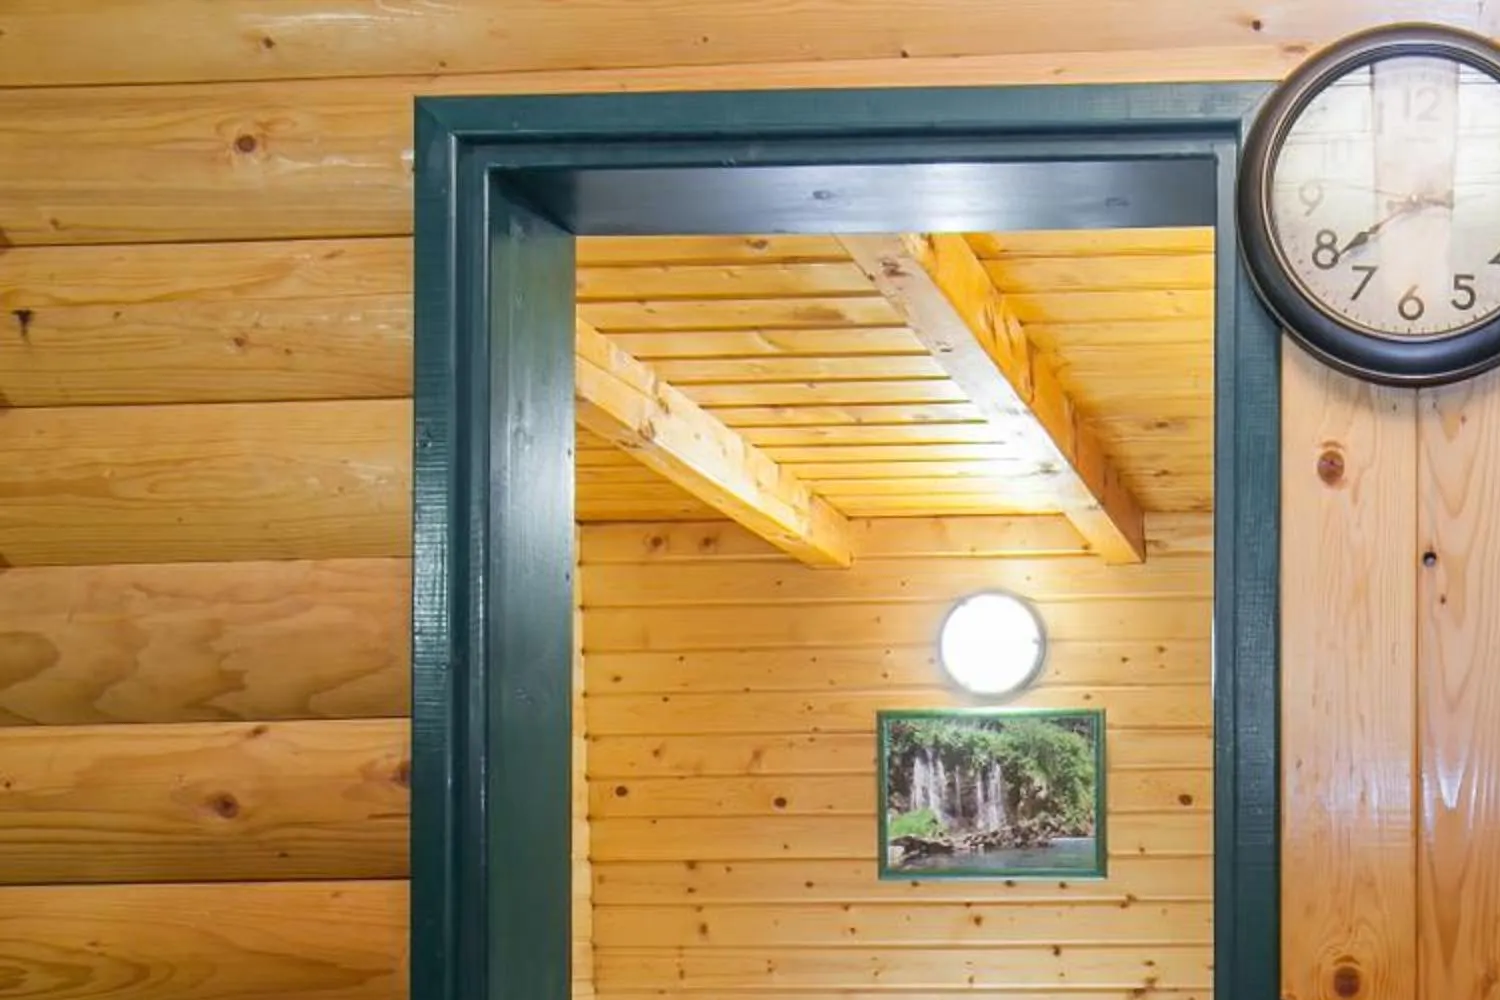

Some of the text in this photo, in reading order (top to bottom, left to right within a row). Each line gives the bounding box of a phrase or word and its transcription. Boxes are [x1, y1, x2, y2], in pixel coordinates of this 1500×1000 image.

[1402, 85, 1441, 122] 12
[1298, 180, 1324, 217] 9
[1311, 228, 1339, 270] 8
[1350, 265, 1379, 301] 7
[1451, 274, 1477, 310] 5
[1397, 284, 1425, 321] 6
